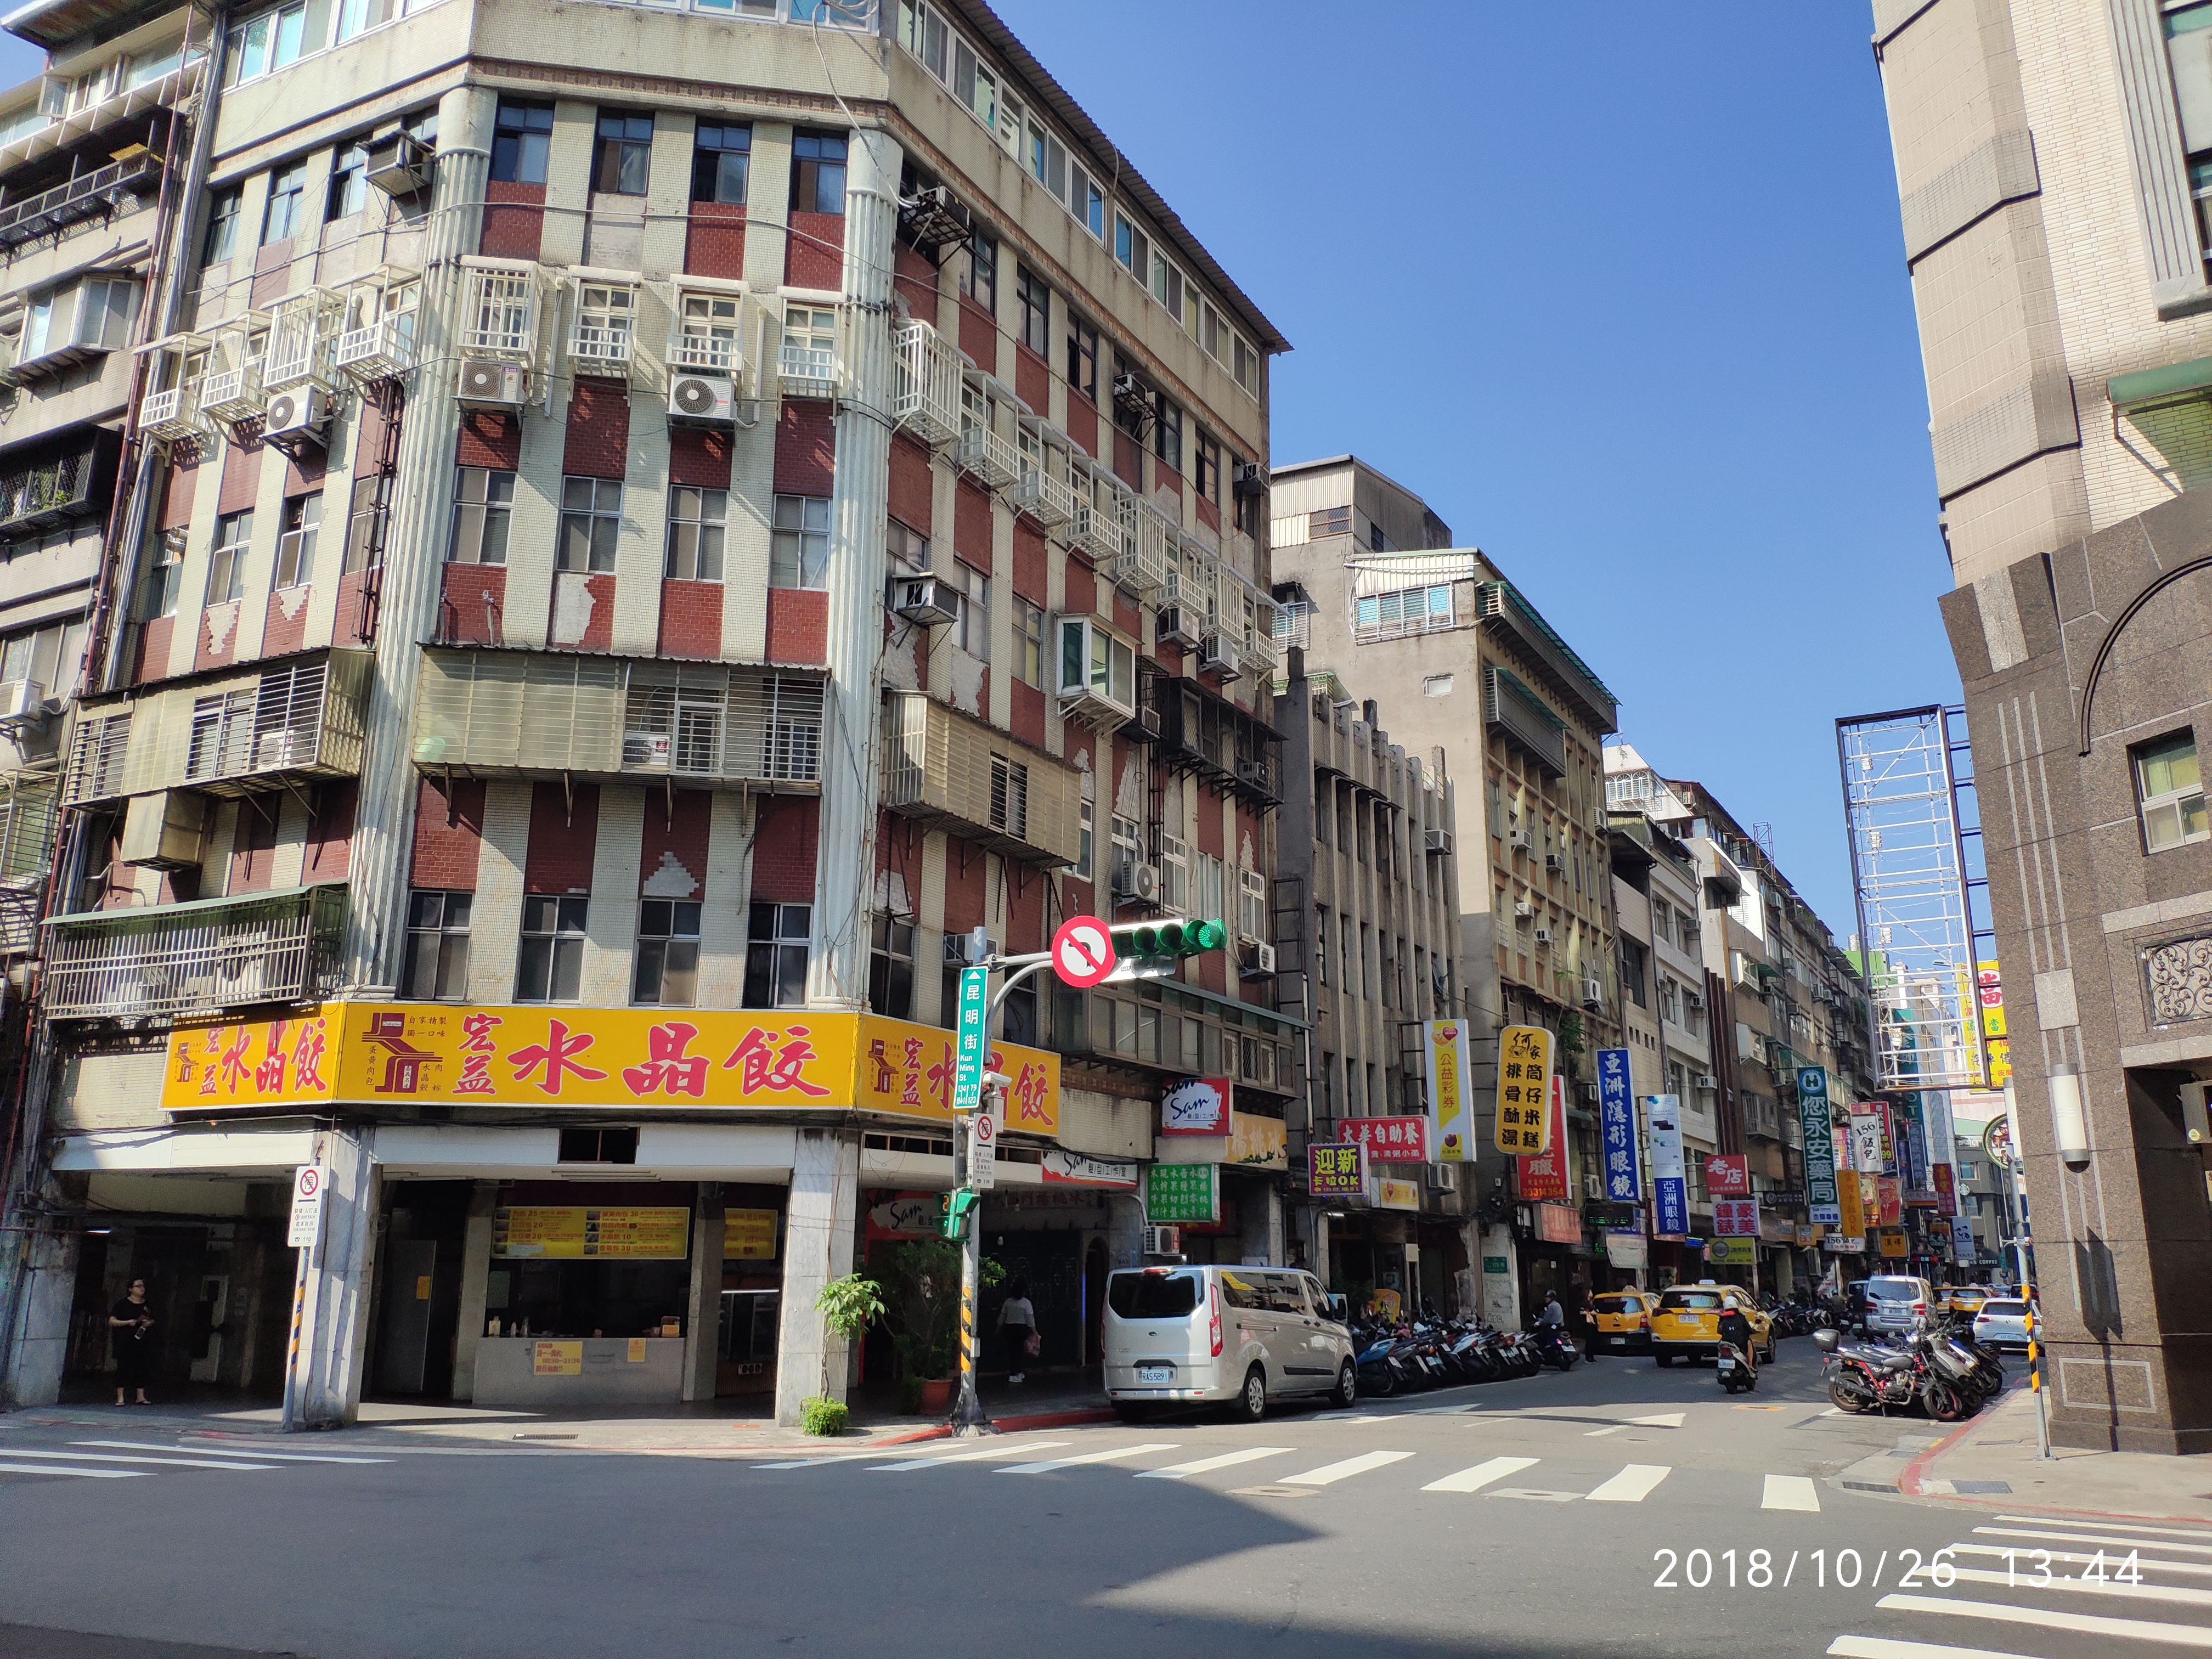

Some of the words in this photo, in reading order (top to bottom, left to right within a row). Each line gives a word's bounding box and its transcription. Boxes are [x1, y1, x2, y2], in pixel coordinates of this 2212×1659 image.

[409, 1016, 447, 1025] 自家精製
[964, 985, 979, 1050] 昆明街
[221, 1018, 326, 1095] 水晶餃
[365, 1045, 377, 1086] 蛋黃肉包
[452, 1012, 504, 1095] 宏益
[507, 1019, 831, 1097] 水晶餃
[960, 1064, 975, 1073] Ming
[420, 1063, 431, 1092] 水晶餃
[900, 1036, 924, 1107] 宏益
[1440, 1053, 1454, 1108] 公益彩券
[1171, 1097, 1210, 1120] Sam
[1502, 1063, 1522, 1146] 排骨酥湯
[1523, 1063, 1543, 1148] 筒仔米糕
[981, 1123, 989, 1135] 停
[1343, 1122, 1420, 1144] 大華自助餐
[1604, 1052, 1634, 1198] 亞洲隱形眼鏡
[1855, 1121, 1875, 1137] 156
[1314, 1148, 1357, 1174] 迎新
[1802, 1096, 1834, 1203] 您永安藥局
[1860, 1137, 1876, 1160] 飯包
[304, 1176, 314, 1189] 停
[1313, 1176, 1359, 1186] 卡拉OK
[1708, 1158, 1743, 1184] 老店
[1522, 1187, 1564, 1197] 23314354
[1662, 1180, 1680, 1232] 亞洲眼鏡
[890, 1202, 923, 1230] Sam
[1716, 1203, 1735, 1234] 鐘錶
[1736, 1203, 1756, 1234] 豪美
